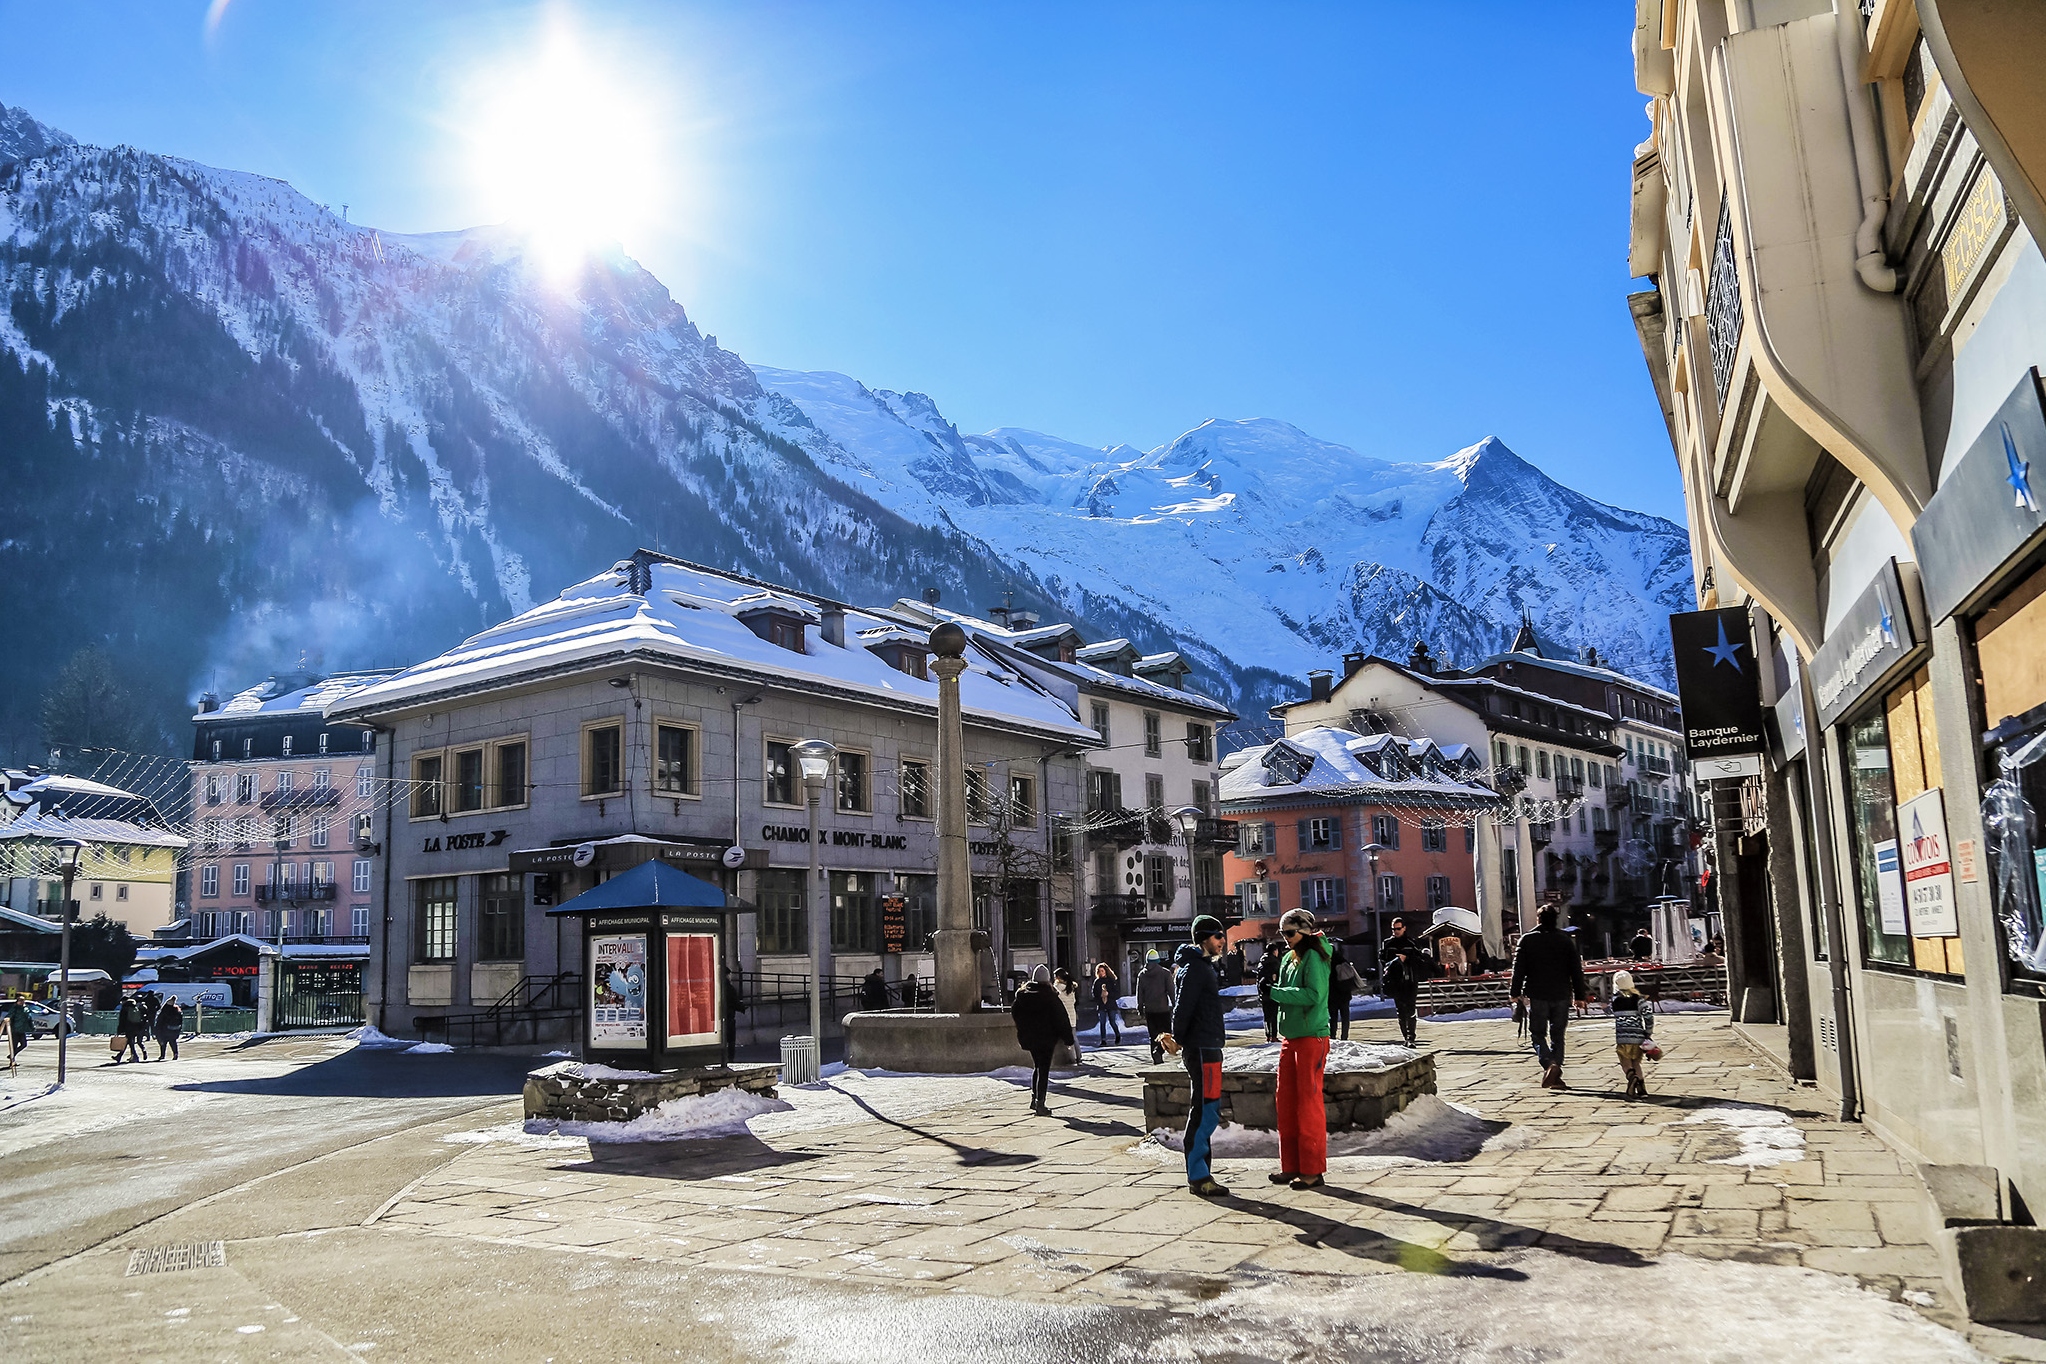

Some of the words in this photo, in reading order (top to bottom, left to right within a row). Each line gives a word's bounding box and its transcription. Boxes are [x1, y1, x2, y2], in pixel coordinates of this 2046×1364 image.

[1689, 725, 1739, 738] Banque
[1690, 733, 1760, 748] Laydernier
[423, 838, 441, 852] LA
[445, 833, 486, 850] POSTE
[762, 825, 828, 844] CHAMOIX
[833, 831, 907, 851] MONT-BLANC
[532, 856, 543, 864] LA
[546, 854, 573, 862] POSTE
[683, 852, 716, 860] POSTE
